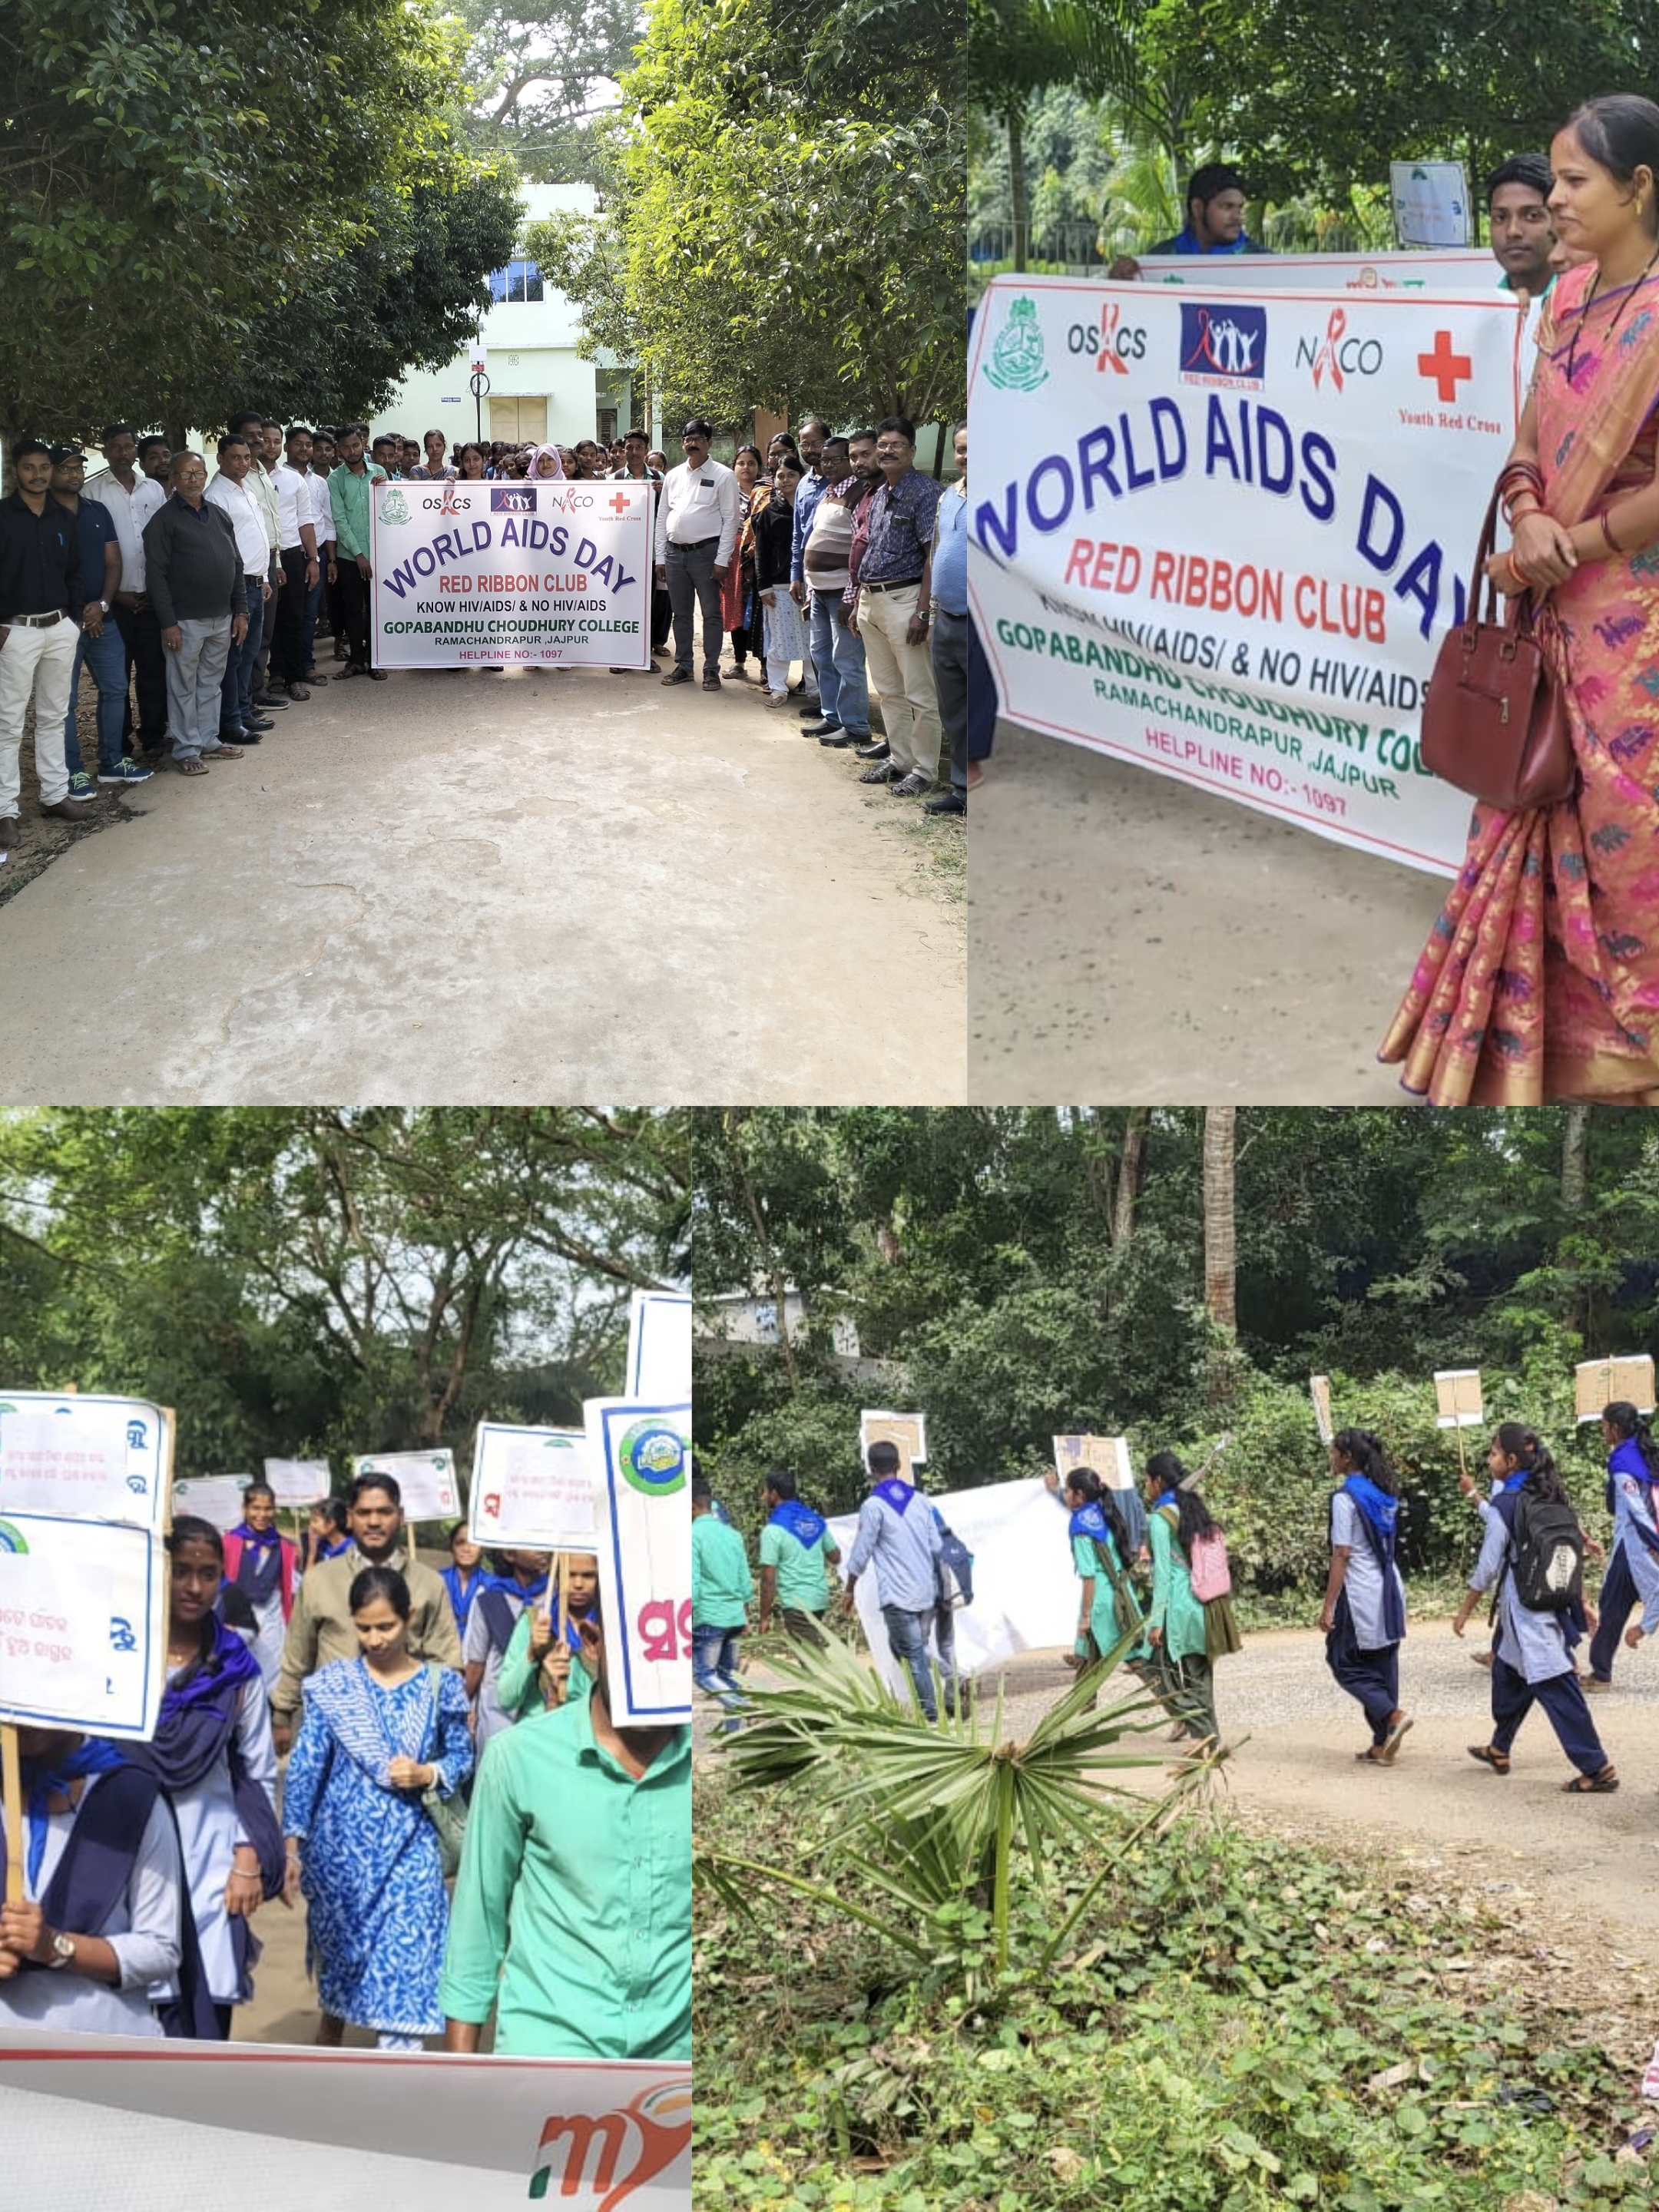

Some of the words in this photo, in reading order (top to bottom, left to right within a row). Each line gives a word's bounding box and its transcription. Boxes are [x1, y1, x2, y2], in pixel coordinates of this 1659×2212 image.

[1295, 321, 1383, 386] NACO
[1398, 409, 1434, 427] Youth
[1439, 412, 1463, 430] Red
[1466, 415, 1502, 435] Cross
[1206, 394, 1336, 522] AIDS
[422, 494, 472, 512] OSACS
[551, 494, 594, 510] NACO
[382, 521, 492, 599] WORLD
[501, 518, 569, 556] AIDS
[574, 537, 637, 594] DAY
[439, 575, 472, 593] RED
[478, 575, 539, 593] RIBBON
[547, 574, 588, 592] CLUB
[1065, 538, 1141, 594] RED
[1151, 551, 1286, 623] RIBBON
[1294, 574, 1387, 644] CLUB
[416, 601, 455, 614] KNOW
[459, 600, 516, 613] HIV/AIDS/
[518, 600, 528, 611] &
[531, 600, 550, 611] NO
[553, 599, 607, 611] HIV/AIDS
[384, 621, 484, 634] GOPABANDHU
[487, 619, 576, 633] CHOUDHURY
[578, 619, 640, 634] COLLEGE
[435, 635, 541, 646] RAMACHANDRAPUR
[459, 650, 511, 660] HELPLINE
[514, 650, 537, 660] NO:-
[540, 649, 563, 659] 1097
[1231, 643, 1250, 675] &
[1260, 647, 1301, 687] NO
[995, 618, 1181, 690] GOPABANDHU
[1184, 674, 1369, 753] CHOUDHURY
[1094, 680, 1303, 762] RAMACHANDRAPUR
[1146, 727, 1242, 780] HELPLINE
[1303, 783, 1347, 817] 1097
